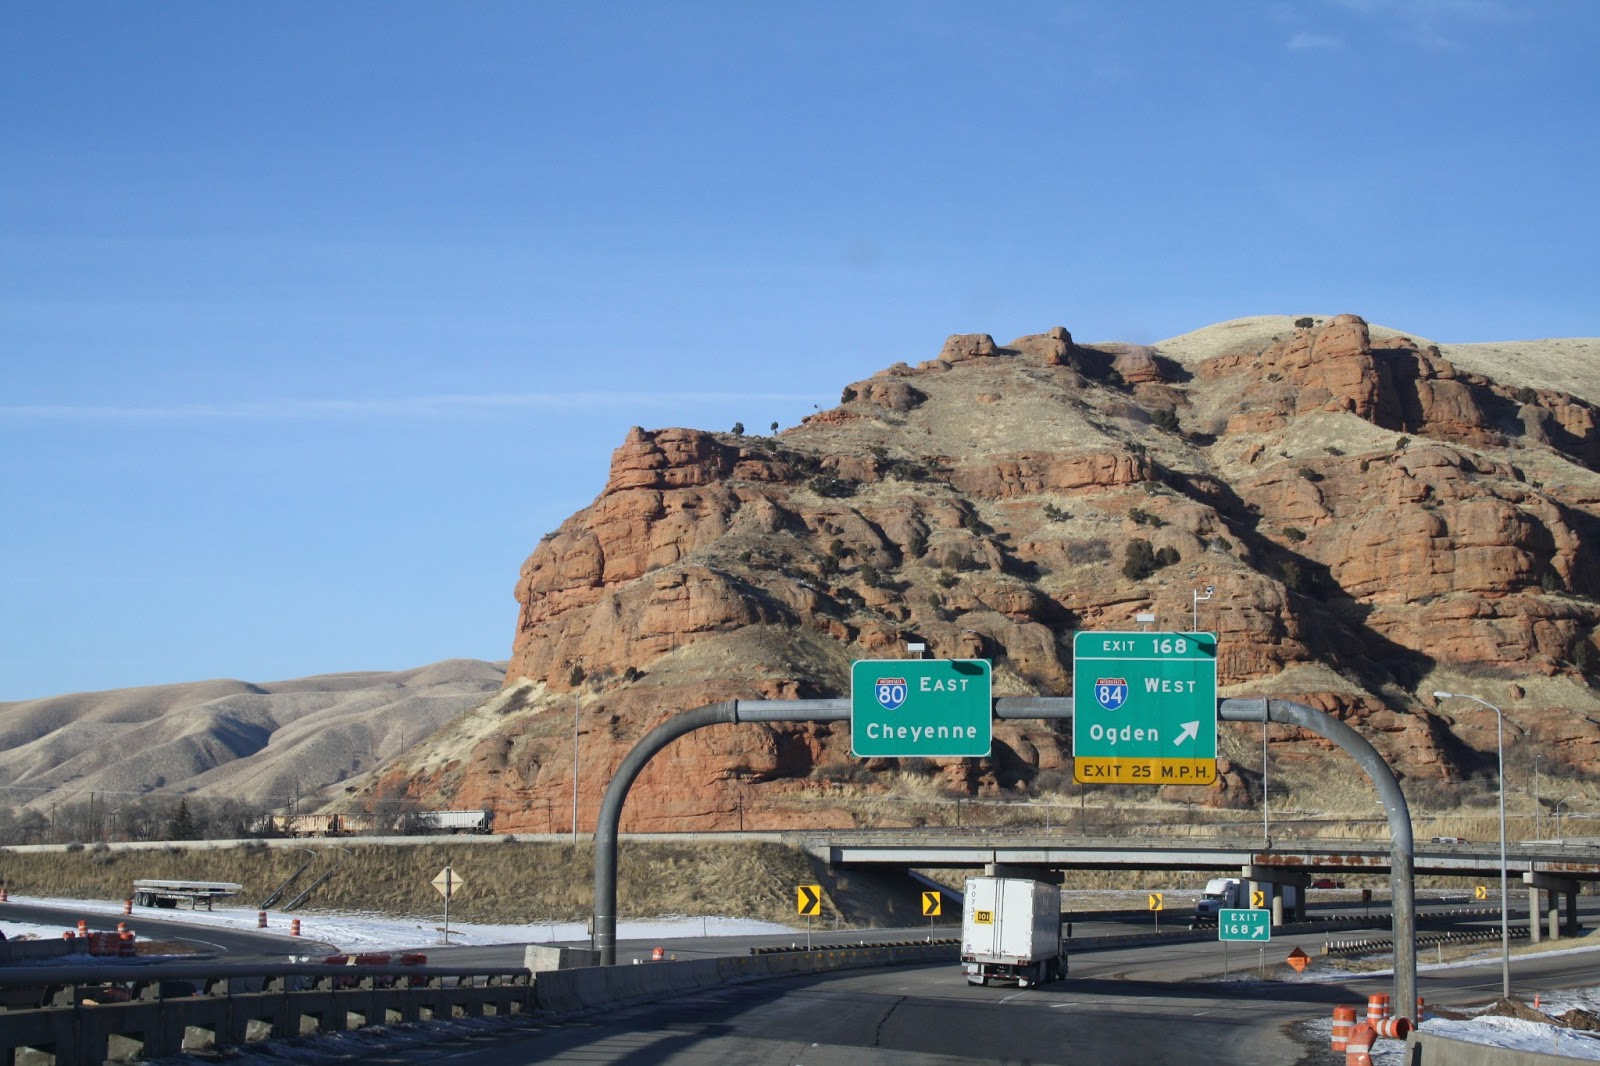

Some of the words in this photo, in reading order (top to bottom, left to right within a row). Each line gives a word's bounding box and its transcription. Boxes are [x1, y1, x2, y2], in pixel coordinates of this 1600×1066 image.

[1103, 640, 1135, 652] EXIT
[1153, 639, 1187, 654] 168
[920, 676, 969, 692] EAST
[1144, 677, 1197, 693] WEST
[879, 685, 904, 704] 80
[1099, 686, 1123, 704] 84
[867, 722, 977, 743] Cheyenne
[1090, 724, 1159, 745] Ogden
[1083, 764, 1122, 777] EXIT
[1131, 765, 1152, 778] 25
[1161, 766, 1211, 778] M.P.H.
[1231, 913, 1258, 921] EXIT
[1224, 924, 1249, 934] 168
